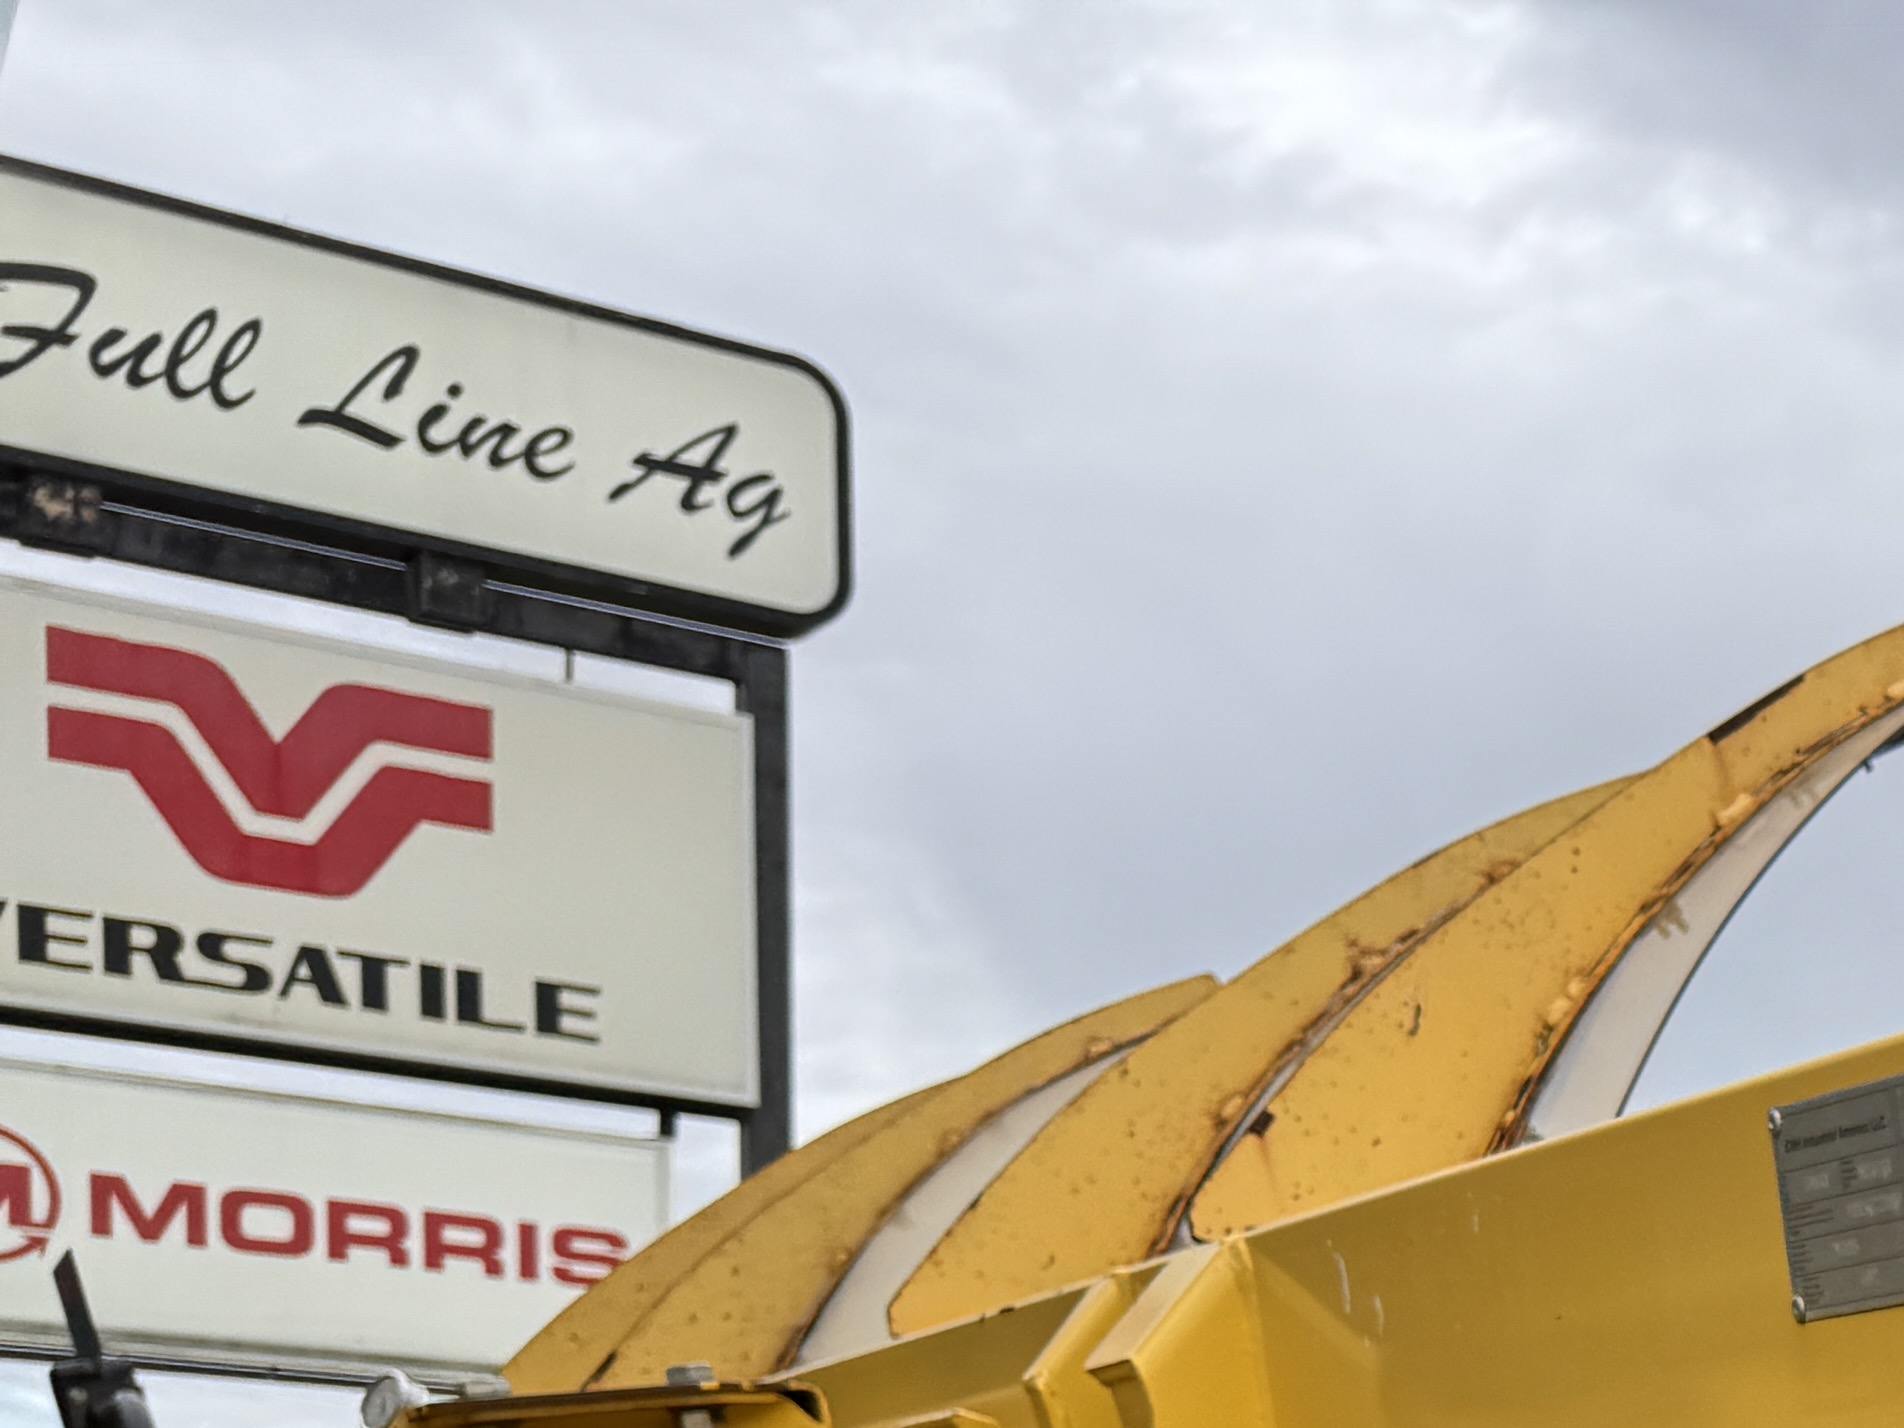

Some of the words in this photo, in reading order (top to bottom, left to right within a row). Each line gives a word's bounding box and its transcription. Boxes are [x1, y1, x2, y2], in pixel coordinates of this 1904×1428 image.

[0, 262, 263, 410] Full
[297, 344, 577, 482] Line
[608, 422, 792, 558] Ag
[0, 899, 603, 1043] ERSATILE
[89, 1170, 630, 1288] MORRIS
